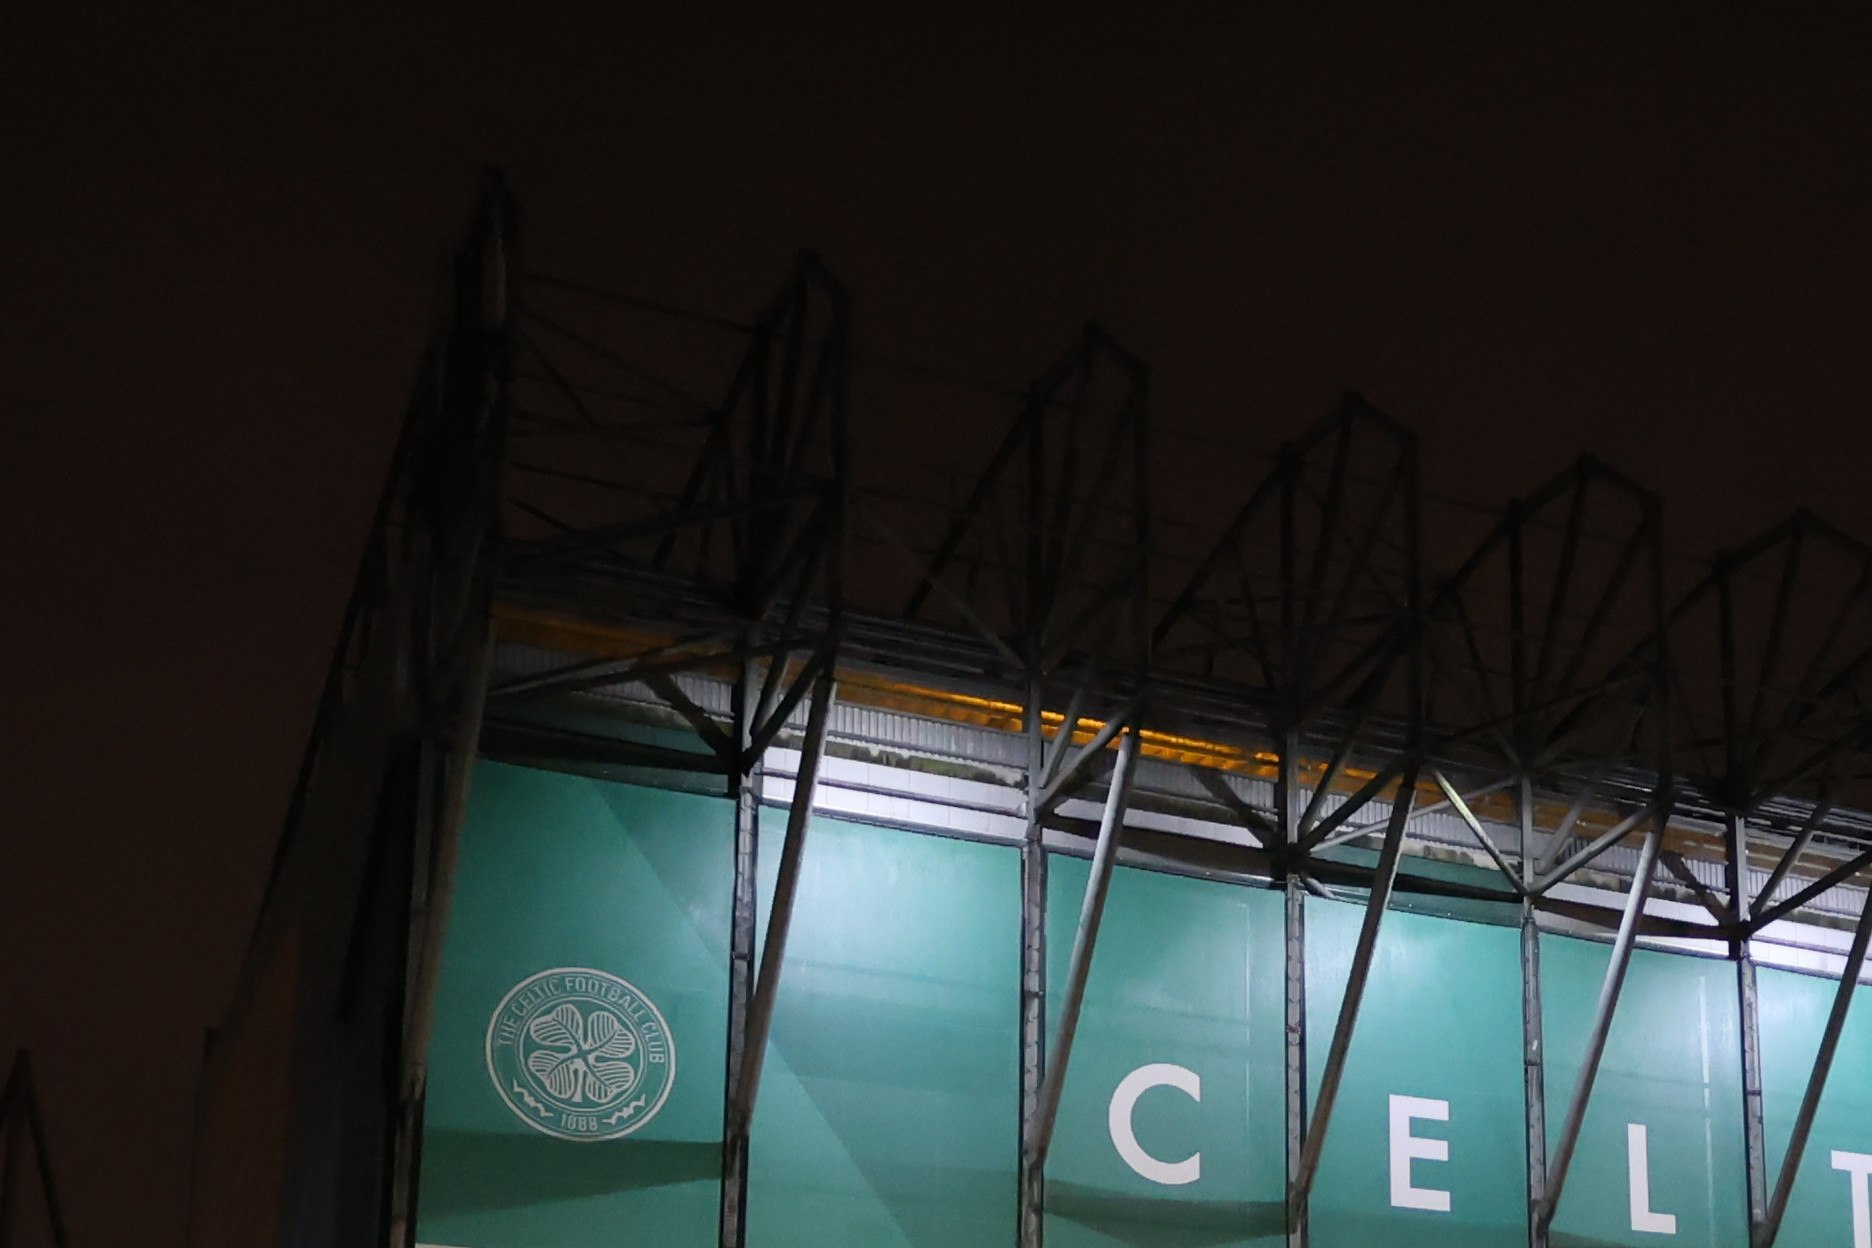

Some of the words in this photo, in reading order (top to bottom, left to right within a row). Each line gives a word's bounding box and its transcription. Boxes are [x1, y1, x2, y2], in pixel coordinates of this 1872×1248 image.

[511, 978, 562, 1017] CELTIC
[565, 976, 646, 1022] FOOTBALL
[641, 1022, 664, 1063] CLUB
[561, 1114, 598, 1131] 1888
